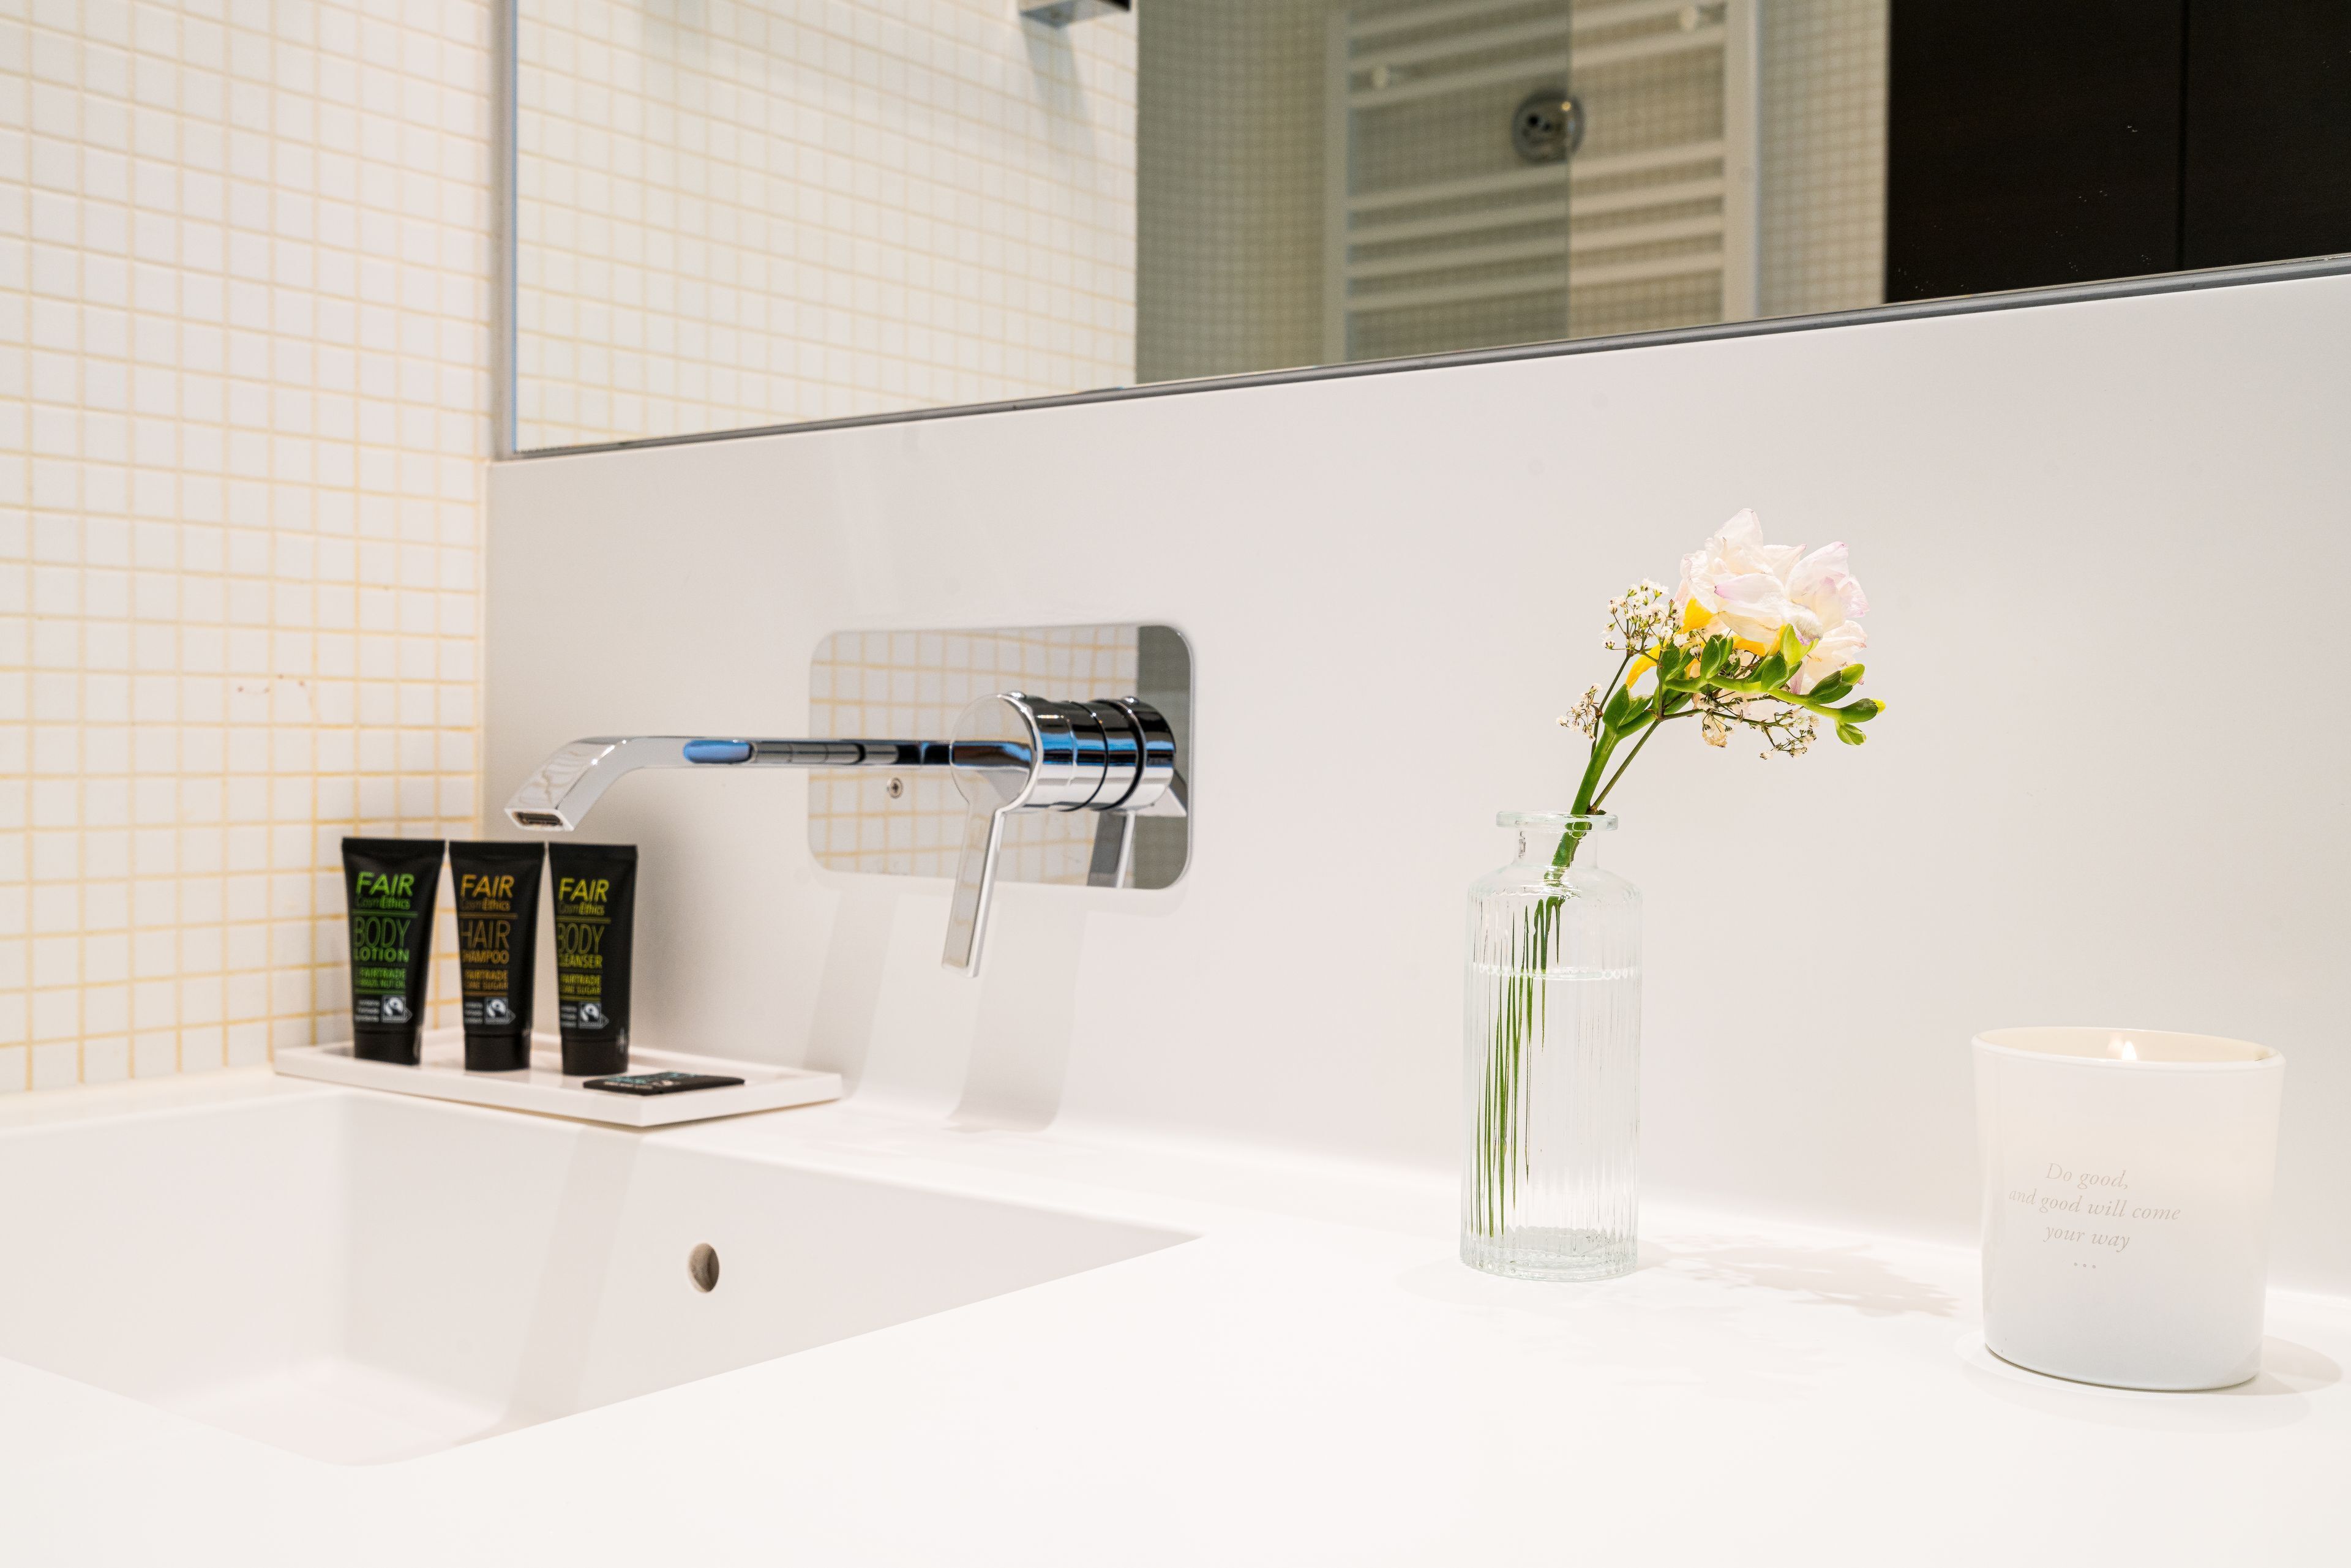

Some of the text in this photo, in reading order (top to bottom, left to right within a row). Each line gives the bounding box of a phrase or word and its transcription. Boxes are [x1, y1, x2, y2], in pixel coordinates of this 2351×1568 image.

[356, 871, 414, 896] FAIR
[460, 874, 514, 898] FAIR
[558, 877, 609, 902] FAIR
[353, 917, 411, 948] BODY
[460, 920, 511, 950] HAIR
[558, 923, 605, 955] BODY
[353, 947, 410, 962] LOTION
[2045, 1163, 2128, 1190] Do good,
[2009, 1188, 2181, 1220] and good will come
[2043, 1226, 2130, 1253] your way
